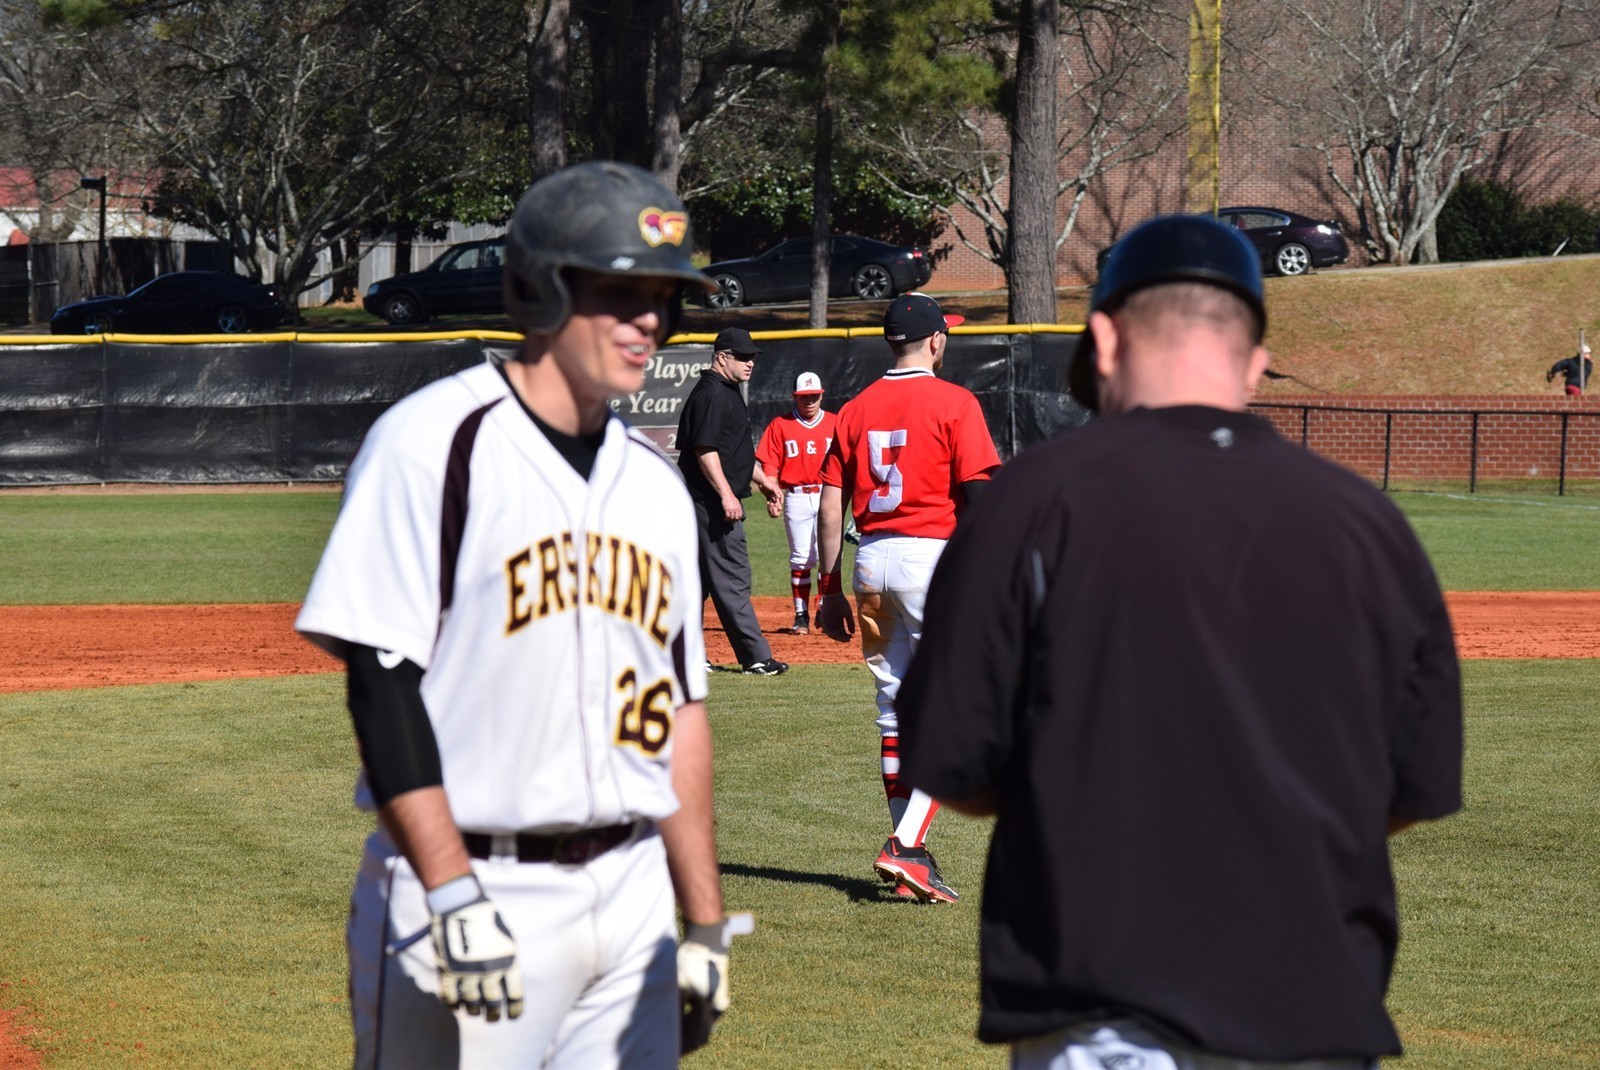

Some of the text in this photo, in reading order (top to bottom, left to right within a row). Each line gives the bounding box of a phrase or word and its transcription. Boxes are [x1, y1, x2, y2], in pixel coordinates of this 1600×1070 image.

[628, 391, 682, 413] Year
[784, 439, 799, 458] D
[806, 440, 817, 455] &
[867, 429, 907, 512] 5
[504, 530, 673, 650] ERSKINE
[613, 666, 674, 756] 26
